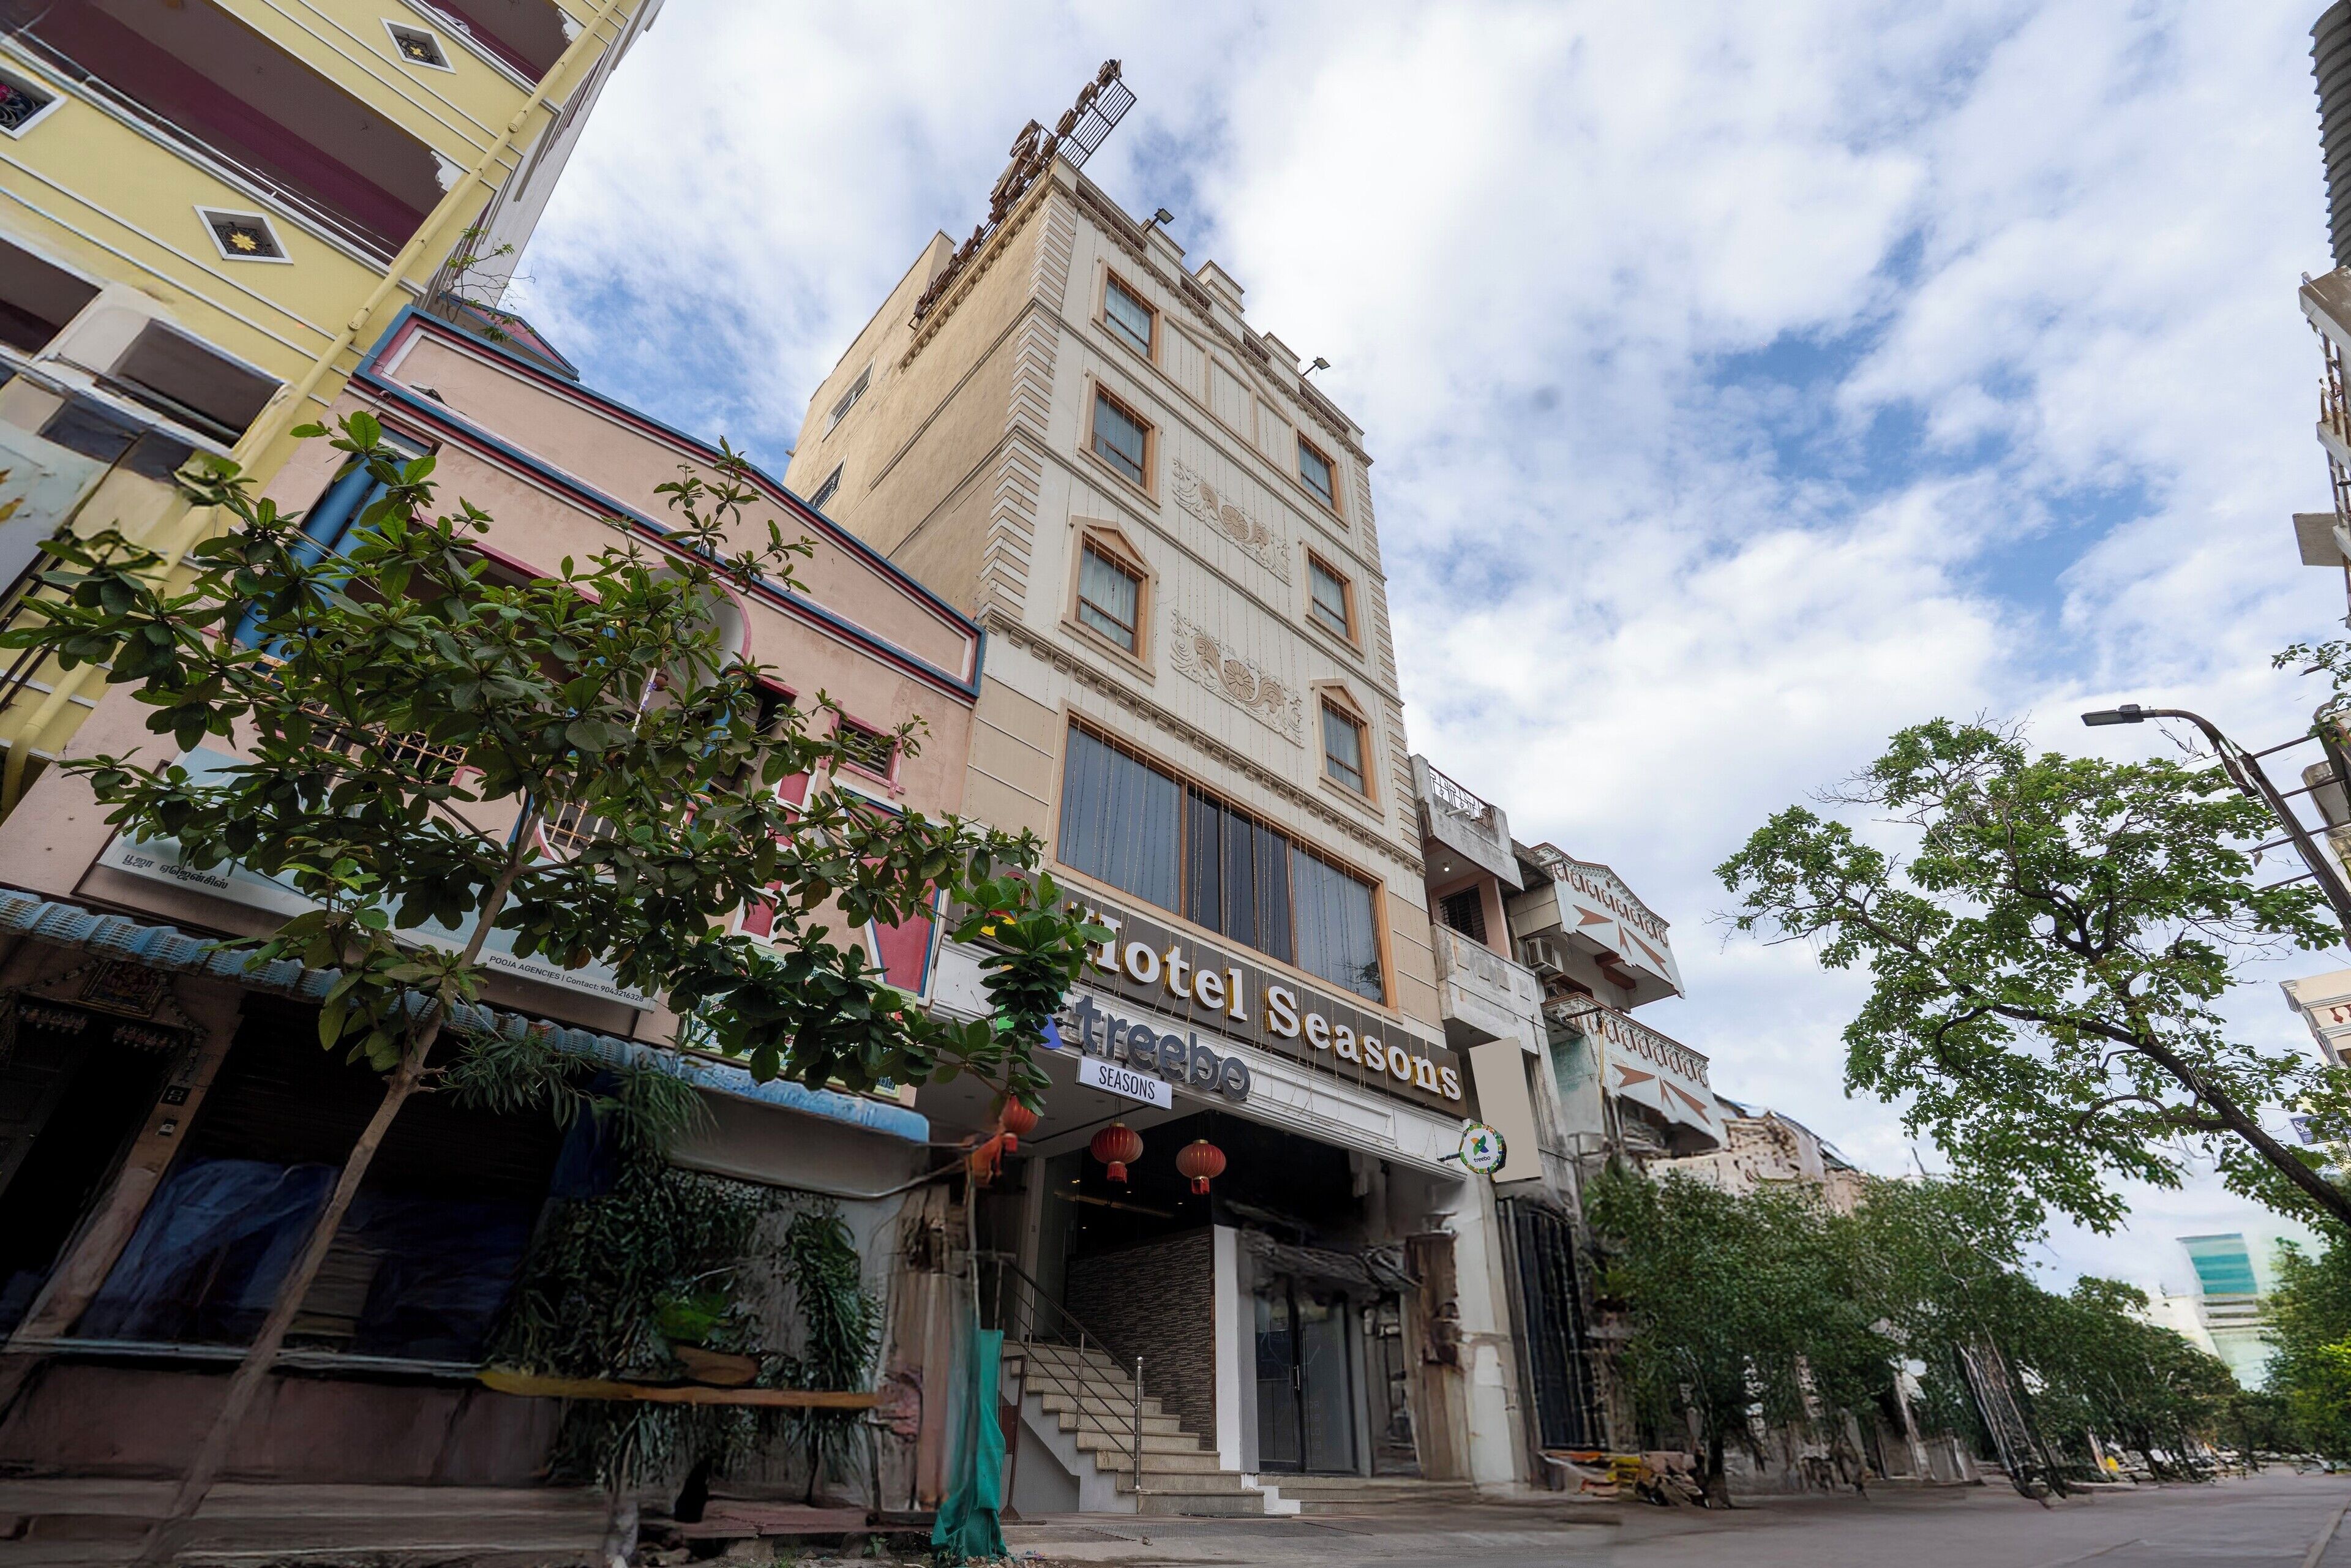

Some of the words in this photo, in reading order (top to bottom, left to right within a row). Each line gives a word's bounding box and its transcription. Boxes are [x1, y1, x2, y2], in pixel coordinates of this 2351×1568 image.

[122, 855, 154, 868] பூஜா
[489, 956, 516, 969] POOJA
[518, 964, 560, 980] AGENCIES
[566, 976, 599, 990] Contact:
[601, 985, 644, 1002] 9043216328
[1075, 995, 1250, 1100] treebo
[1264, 986, 1461, 1101] Seasons
[1099, 1066, 1155, 1100] SEASONS
